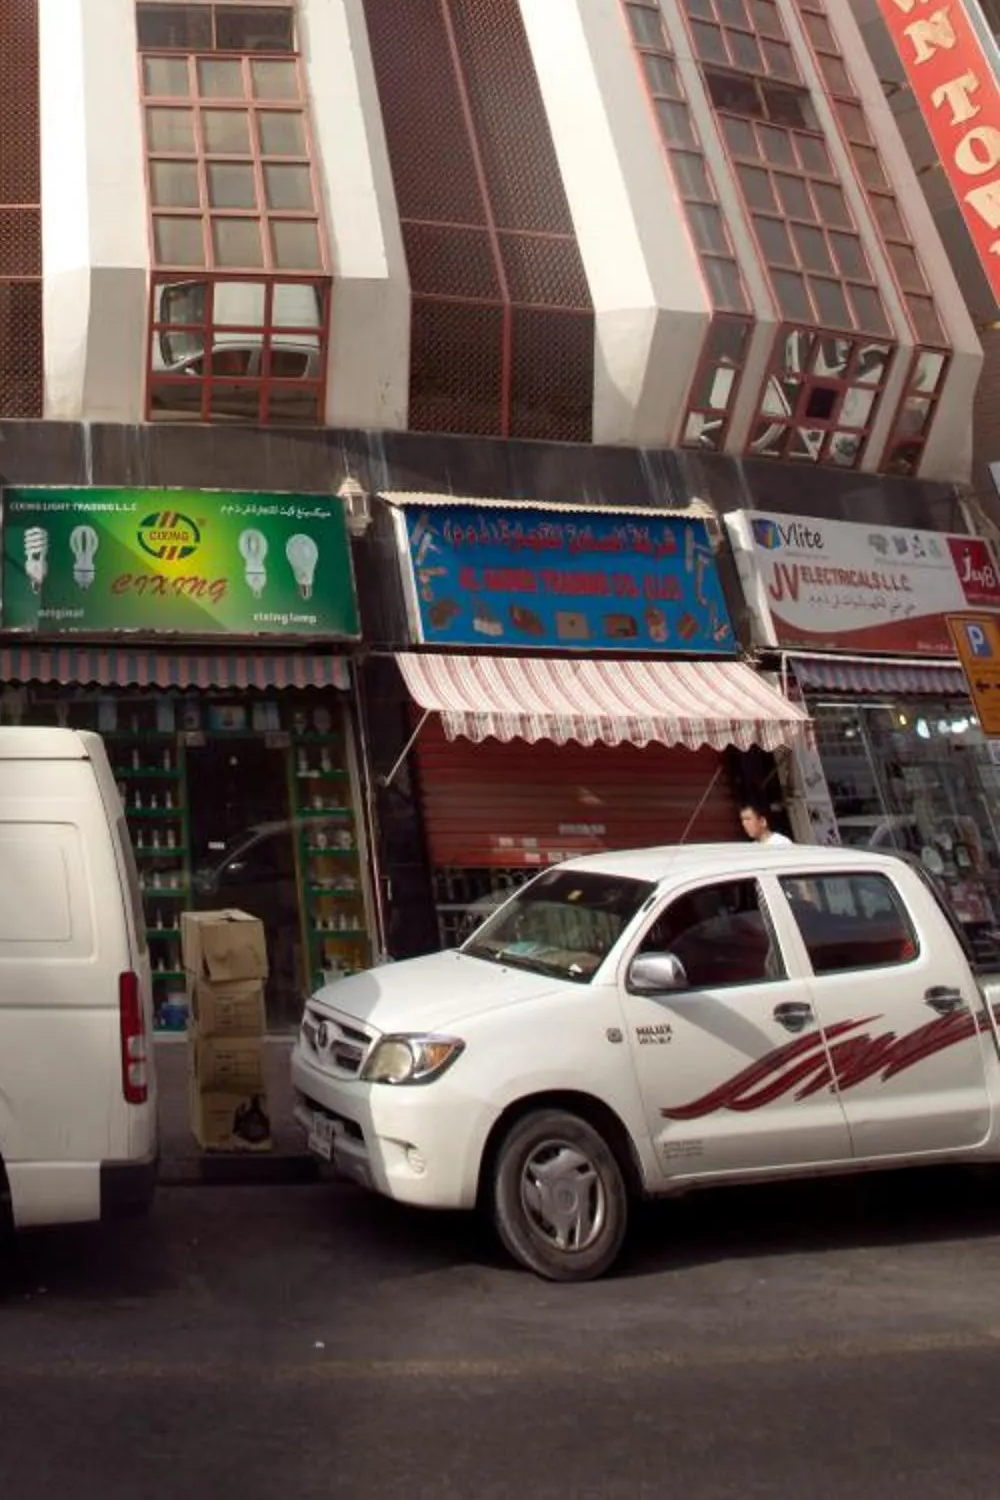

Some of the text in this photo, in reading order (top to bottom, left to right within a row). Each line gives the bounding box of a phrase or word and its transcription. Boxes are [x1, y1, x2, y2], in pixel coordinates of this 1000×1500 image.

[934, 68, 1000, 260] TOW
[769, 561, 799, 602] JV
[967, 625, 984, 656] P
